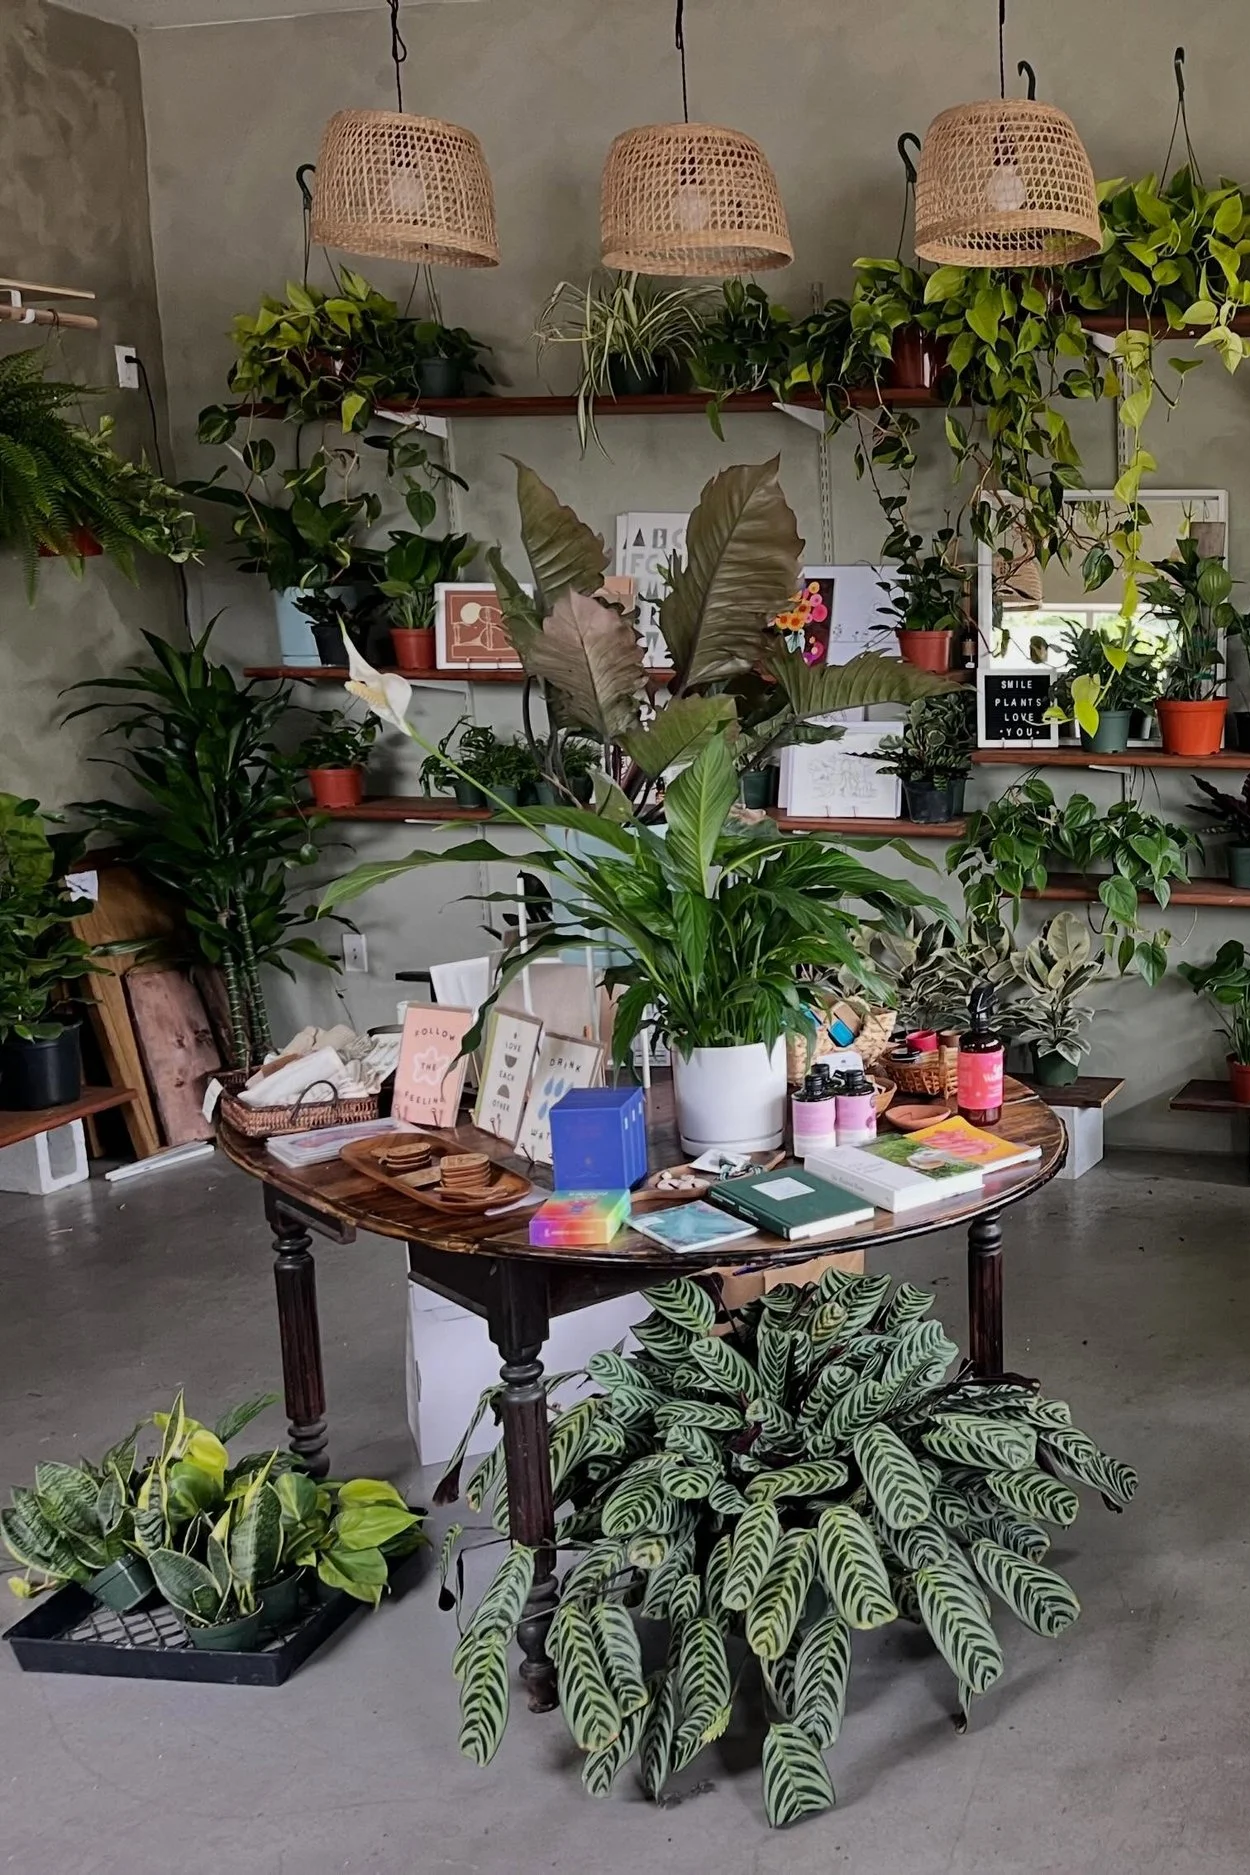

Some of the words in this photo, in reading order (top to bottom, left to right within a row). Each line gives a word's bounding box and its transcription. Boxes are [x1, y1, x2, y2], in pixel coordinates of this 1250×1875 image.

[1001, 680, 1033, 689] SMILE
[995, 698, 1042, 707] PLANTS
[1004, 713, 1034, 722] LOVE
[415, 1027, 456, 1041] FOLLOW
[505, 1041, 522, 1052] LOVE
[421, 1061, 437, 1072] THE
[549, 1058, 582, 1073] DRINK
[499, 1069, 515, 1082] EACH
[492, 1099, 510, 1112] OTHER
[531, 1127, 551, 1140] WAT
